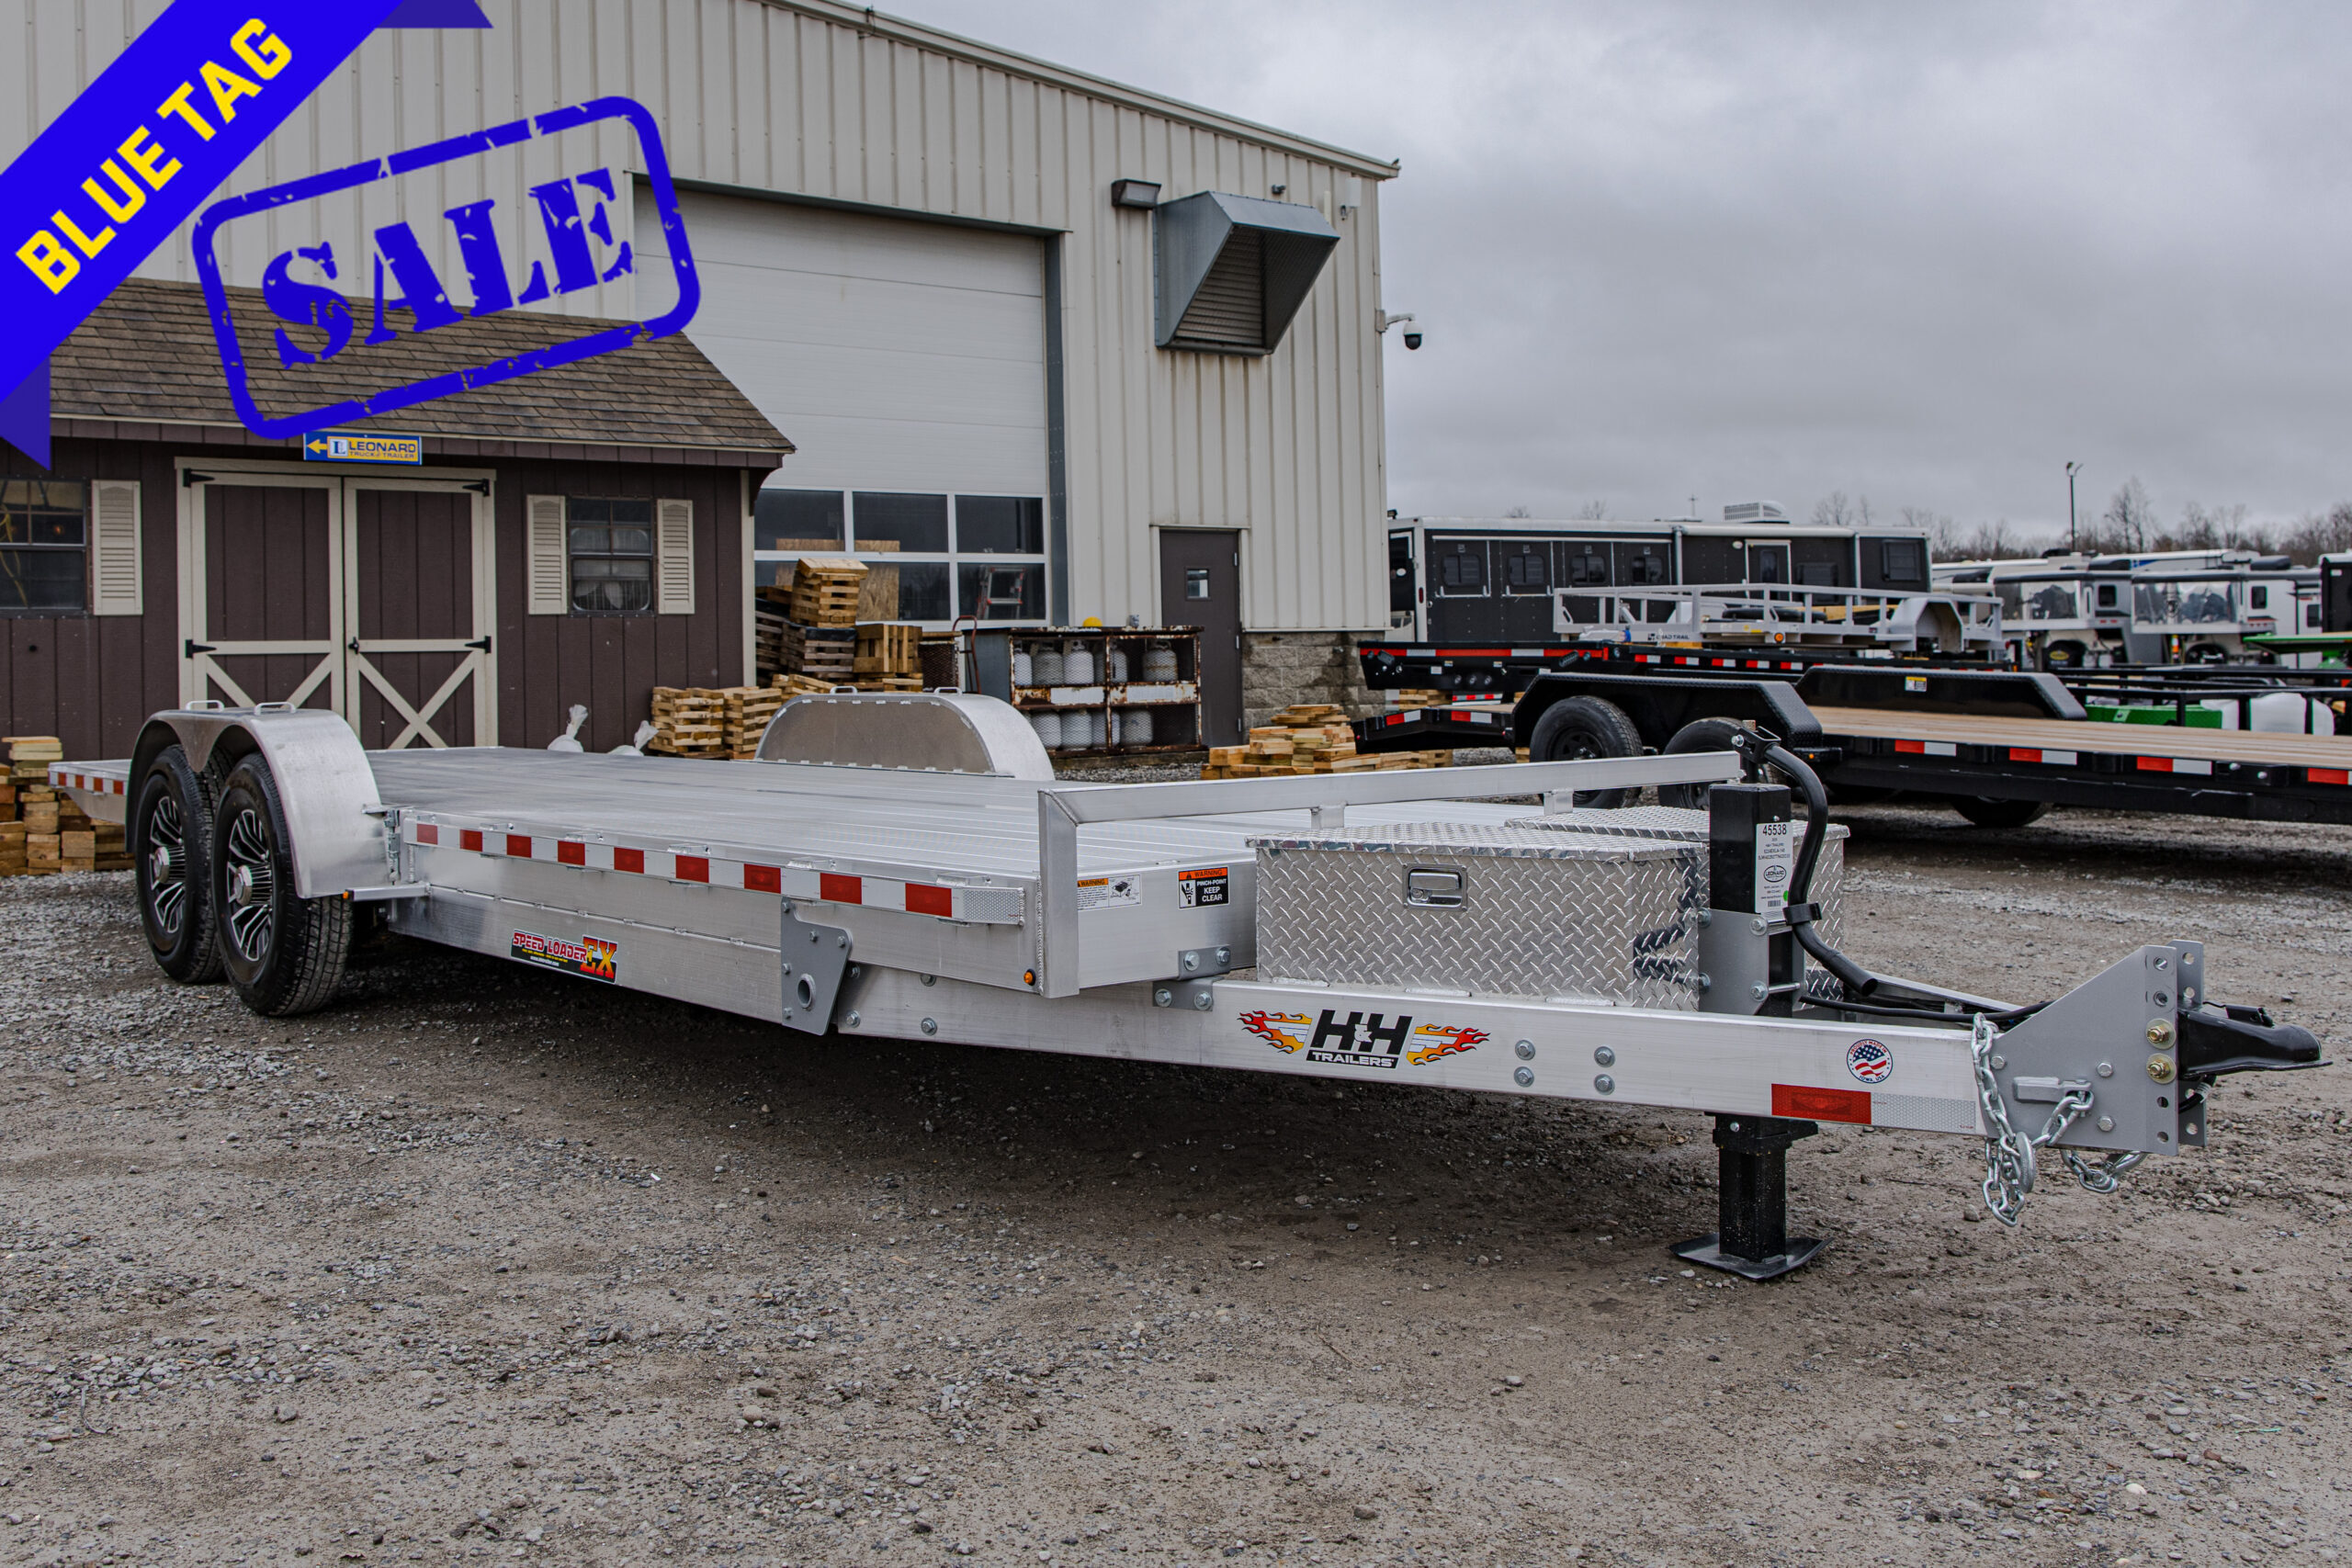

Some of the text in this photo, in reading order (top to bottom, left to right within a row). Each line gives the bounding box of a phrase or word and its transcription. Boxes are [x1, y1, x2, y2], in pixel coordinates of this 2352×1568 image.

[349, 441, 416, 453] LEONARD
[1762, 824, 1787, 836] 45538
[1080, 878, 1105, 886] WARNING
[1196, 878, 1227, 886] PINCH-POINT
[1204, 886, 1220, 894] KEEP
[1202, 894, 1223, 902] CLEAR
[513, 931, 544, 951] SPEED
[548, 940, 588, 962] LOADER
[580, 936, 617, 979] EX
[1310, 1009, 1413, 1055] H&H
[1849, 1041, 1867, 1055] PROUDLY
[1312, 1051, 1392, 1067] TRAILERS
